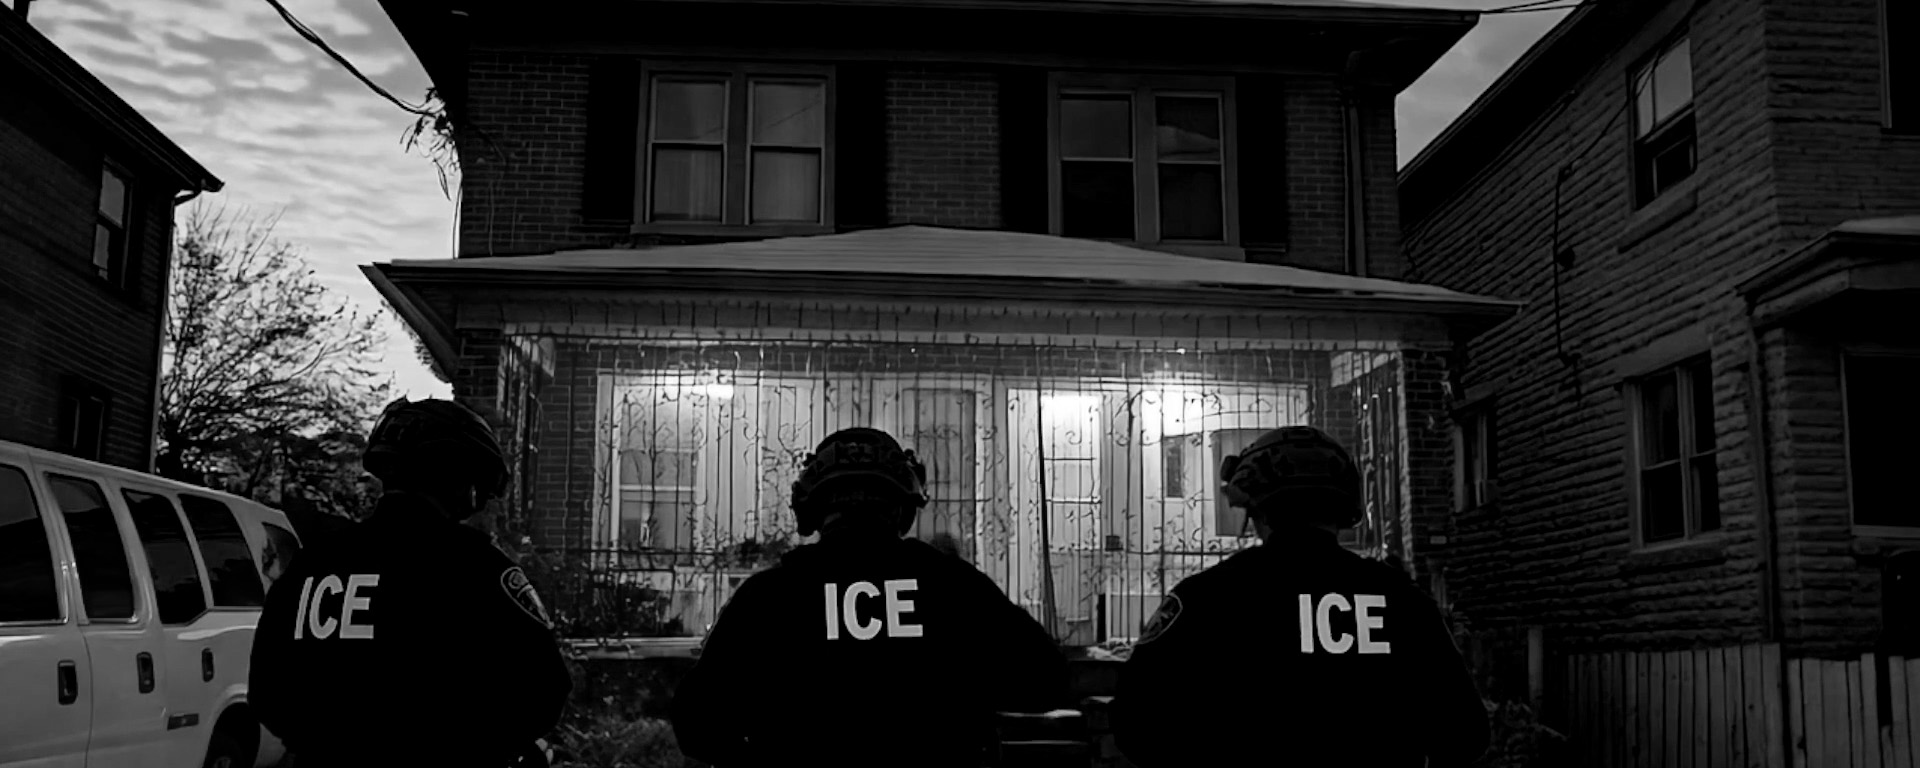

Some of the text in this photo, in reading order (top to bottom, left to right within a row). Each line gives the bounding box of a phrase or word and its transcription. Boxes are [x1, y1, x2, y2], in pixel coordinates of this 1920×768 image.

[294, 574, 380, 639] ICE
[824, 579, 924, 640] ICE
[1298, 593, 1391, 654] ICE
